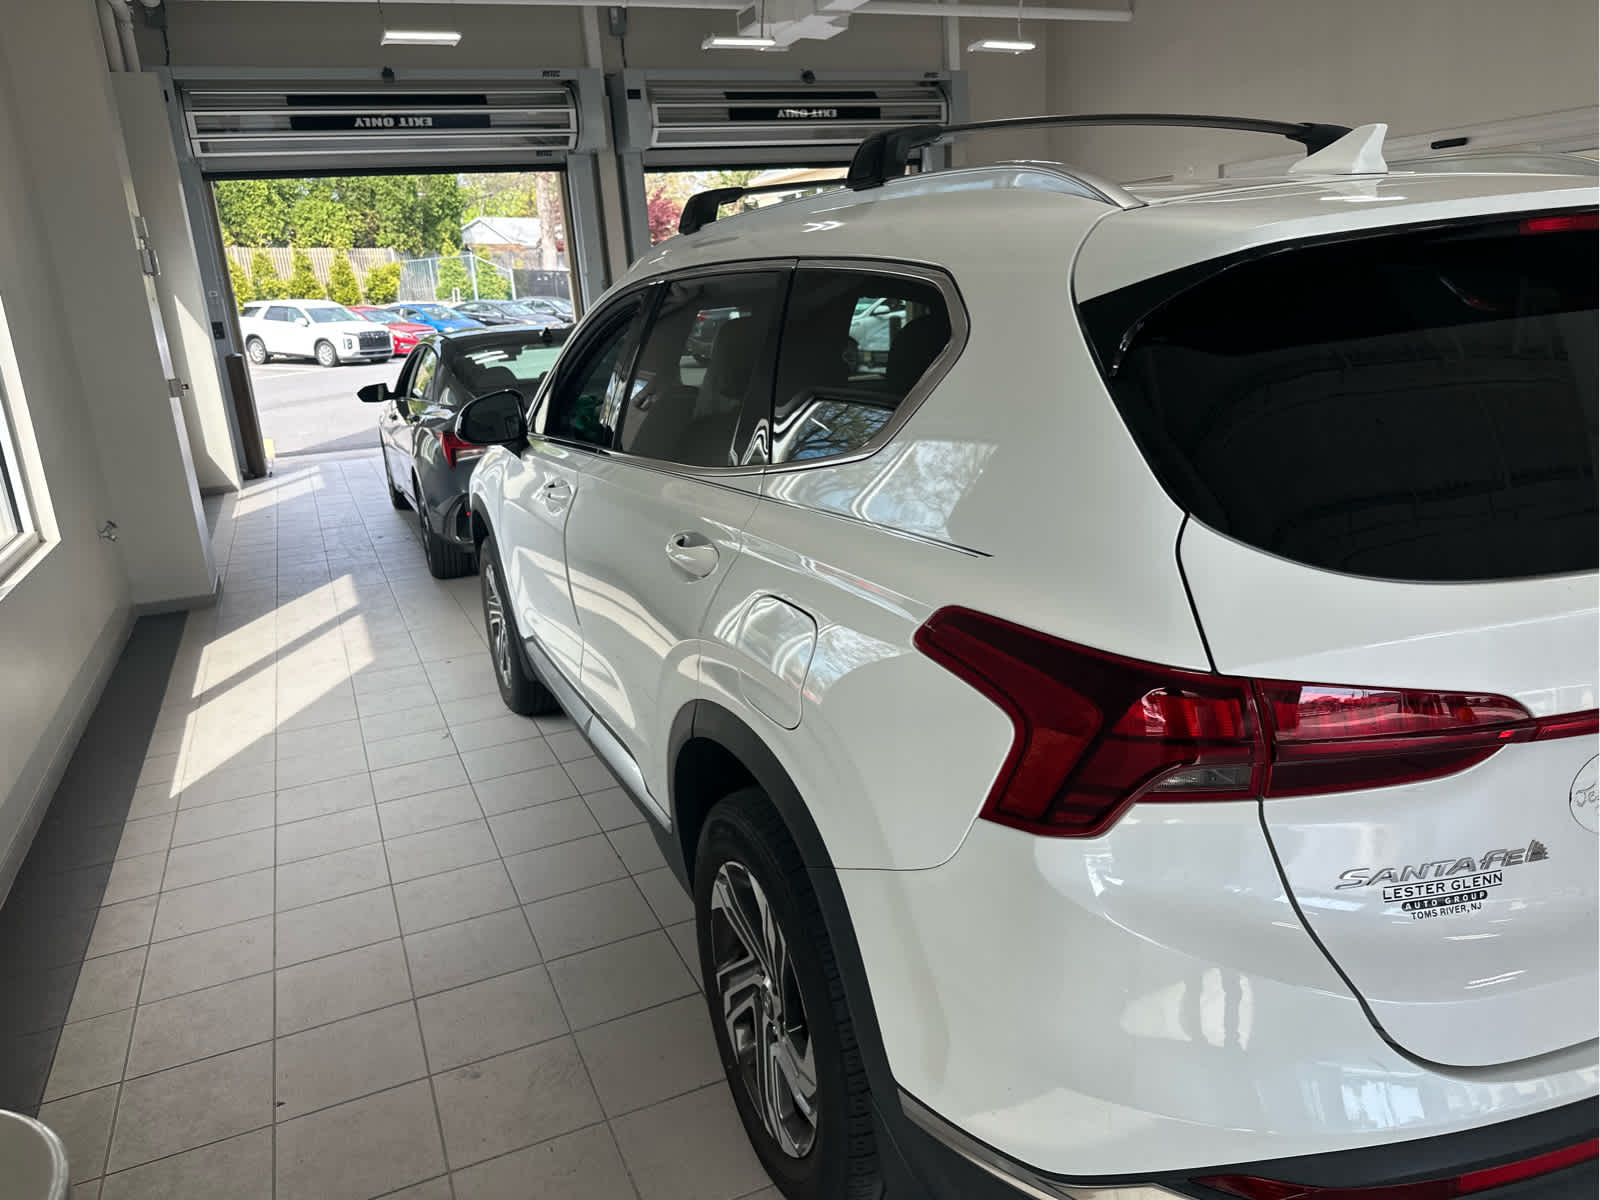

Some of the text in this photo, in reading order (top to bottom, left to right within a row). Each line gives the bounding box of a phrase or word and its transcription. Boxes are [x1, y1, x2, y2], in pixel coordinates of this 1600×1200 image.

[354, 117, 432, 127] EXIT ONLY
[1335, 857, 1477, 890] SANTA
[1383, 872, 1503, 900] LESTER GLENN
[1405, 891, 1486, 911] AUTO GROUP
[1411, 902, 1482, 921] TOMS RIVER, NJ
